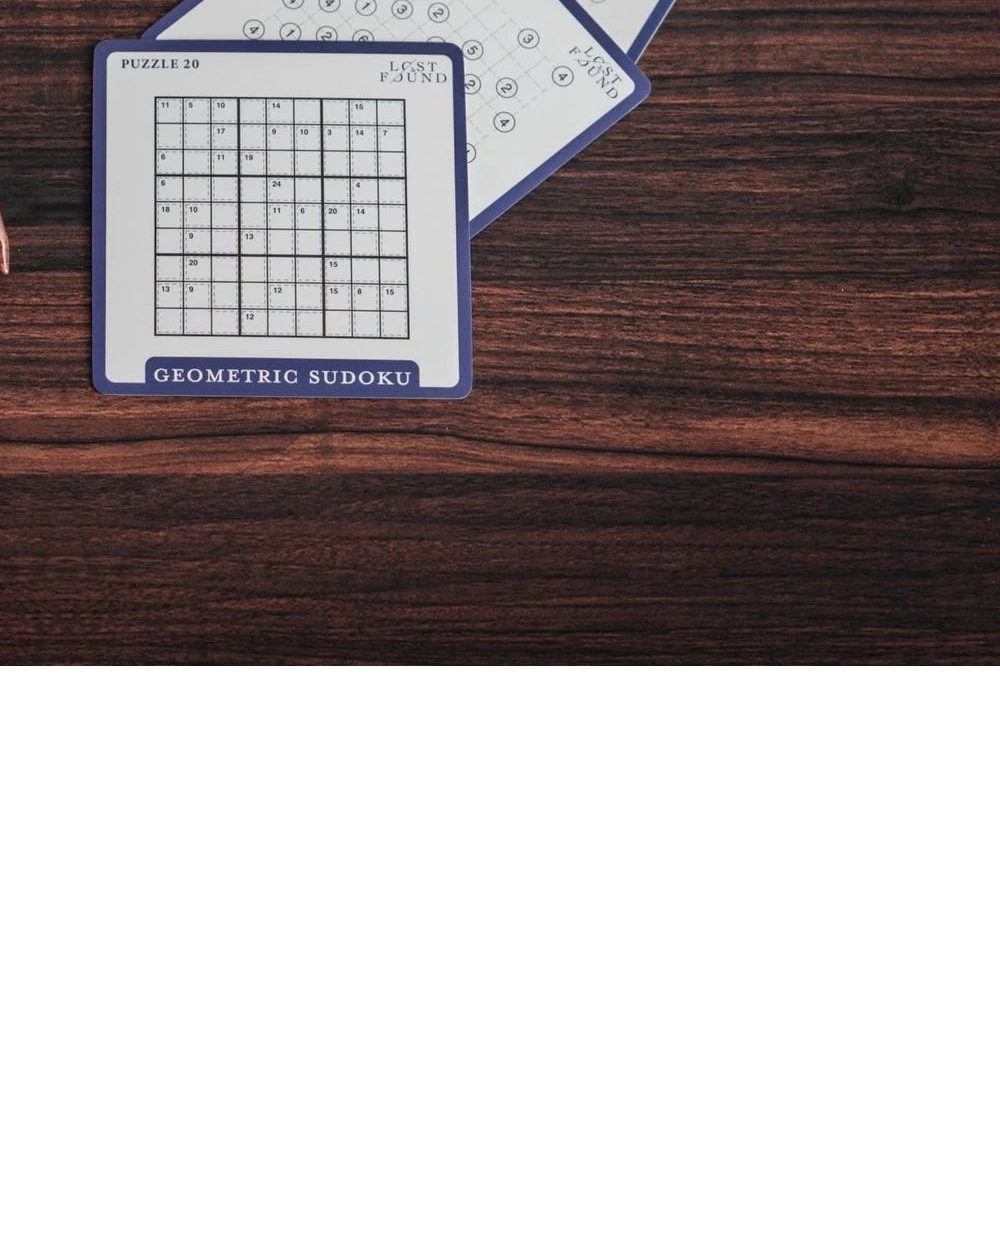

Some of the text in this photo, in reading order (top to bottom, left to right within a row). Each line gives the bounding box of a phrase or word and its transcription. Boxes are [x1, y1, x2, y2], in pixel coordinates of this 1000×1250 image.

[121, 58, 200, 69] PUZZLE 20
[153, 367, 412, 386] GEOMETRIC SUDOKU
